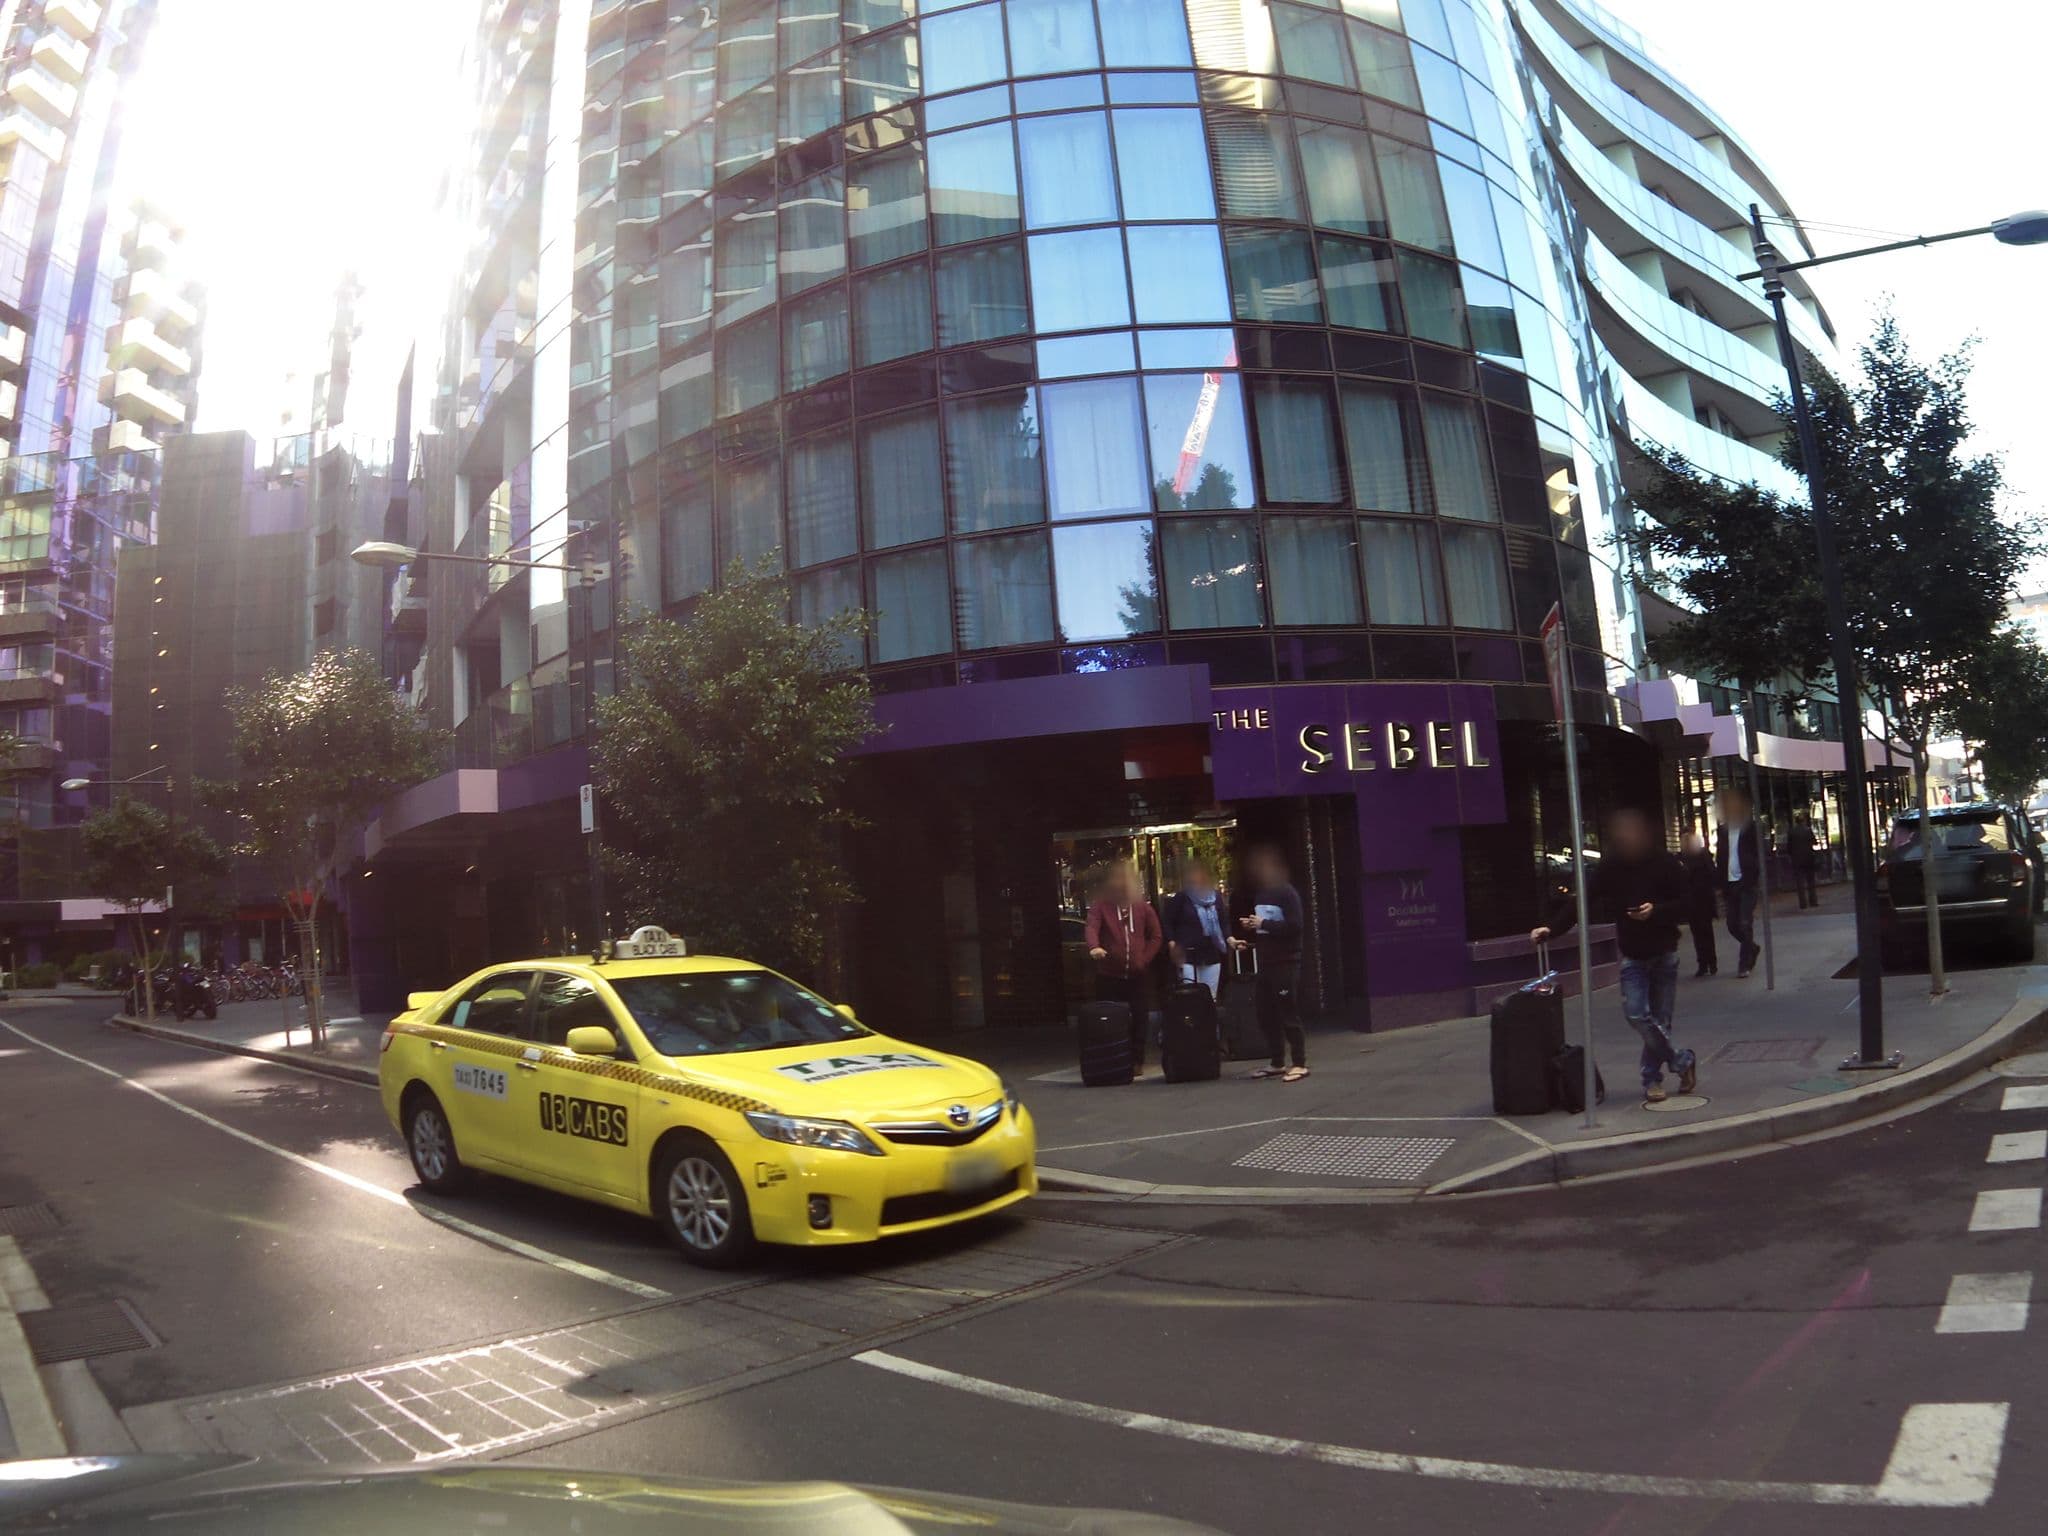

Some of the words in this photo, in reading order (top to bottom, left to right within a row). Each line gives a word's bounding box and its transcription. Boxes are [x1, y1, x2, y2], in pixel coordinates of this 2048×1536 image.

[1212, 708, 1271, 731] THE
[1299, 720, 1491, 774] SEBEL
[643, 930, 668, 943] TAXI
[777, 1053, 931, 1075] TAXI
[455, 1068, 472, 1087] TAXI
[473, 1068, 505, 1094] 7645
